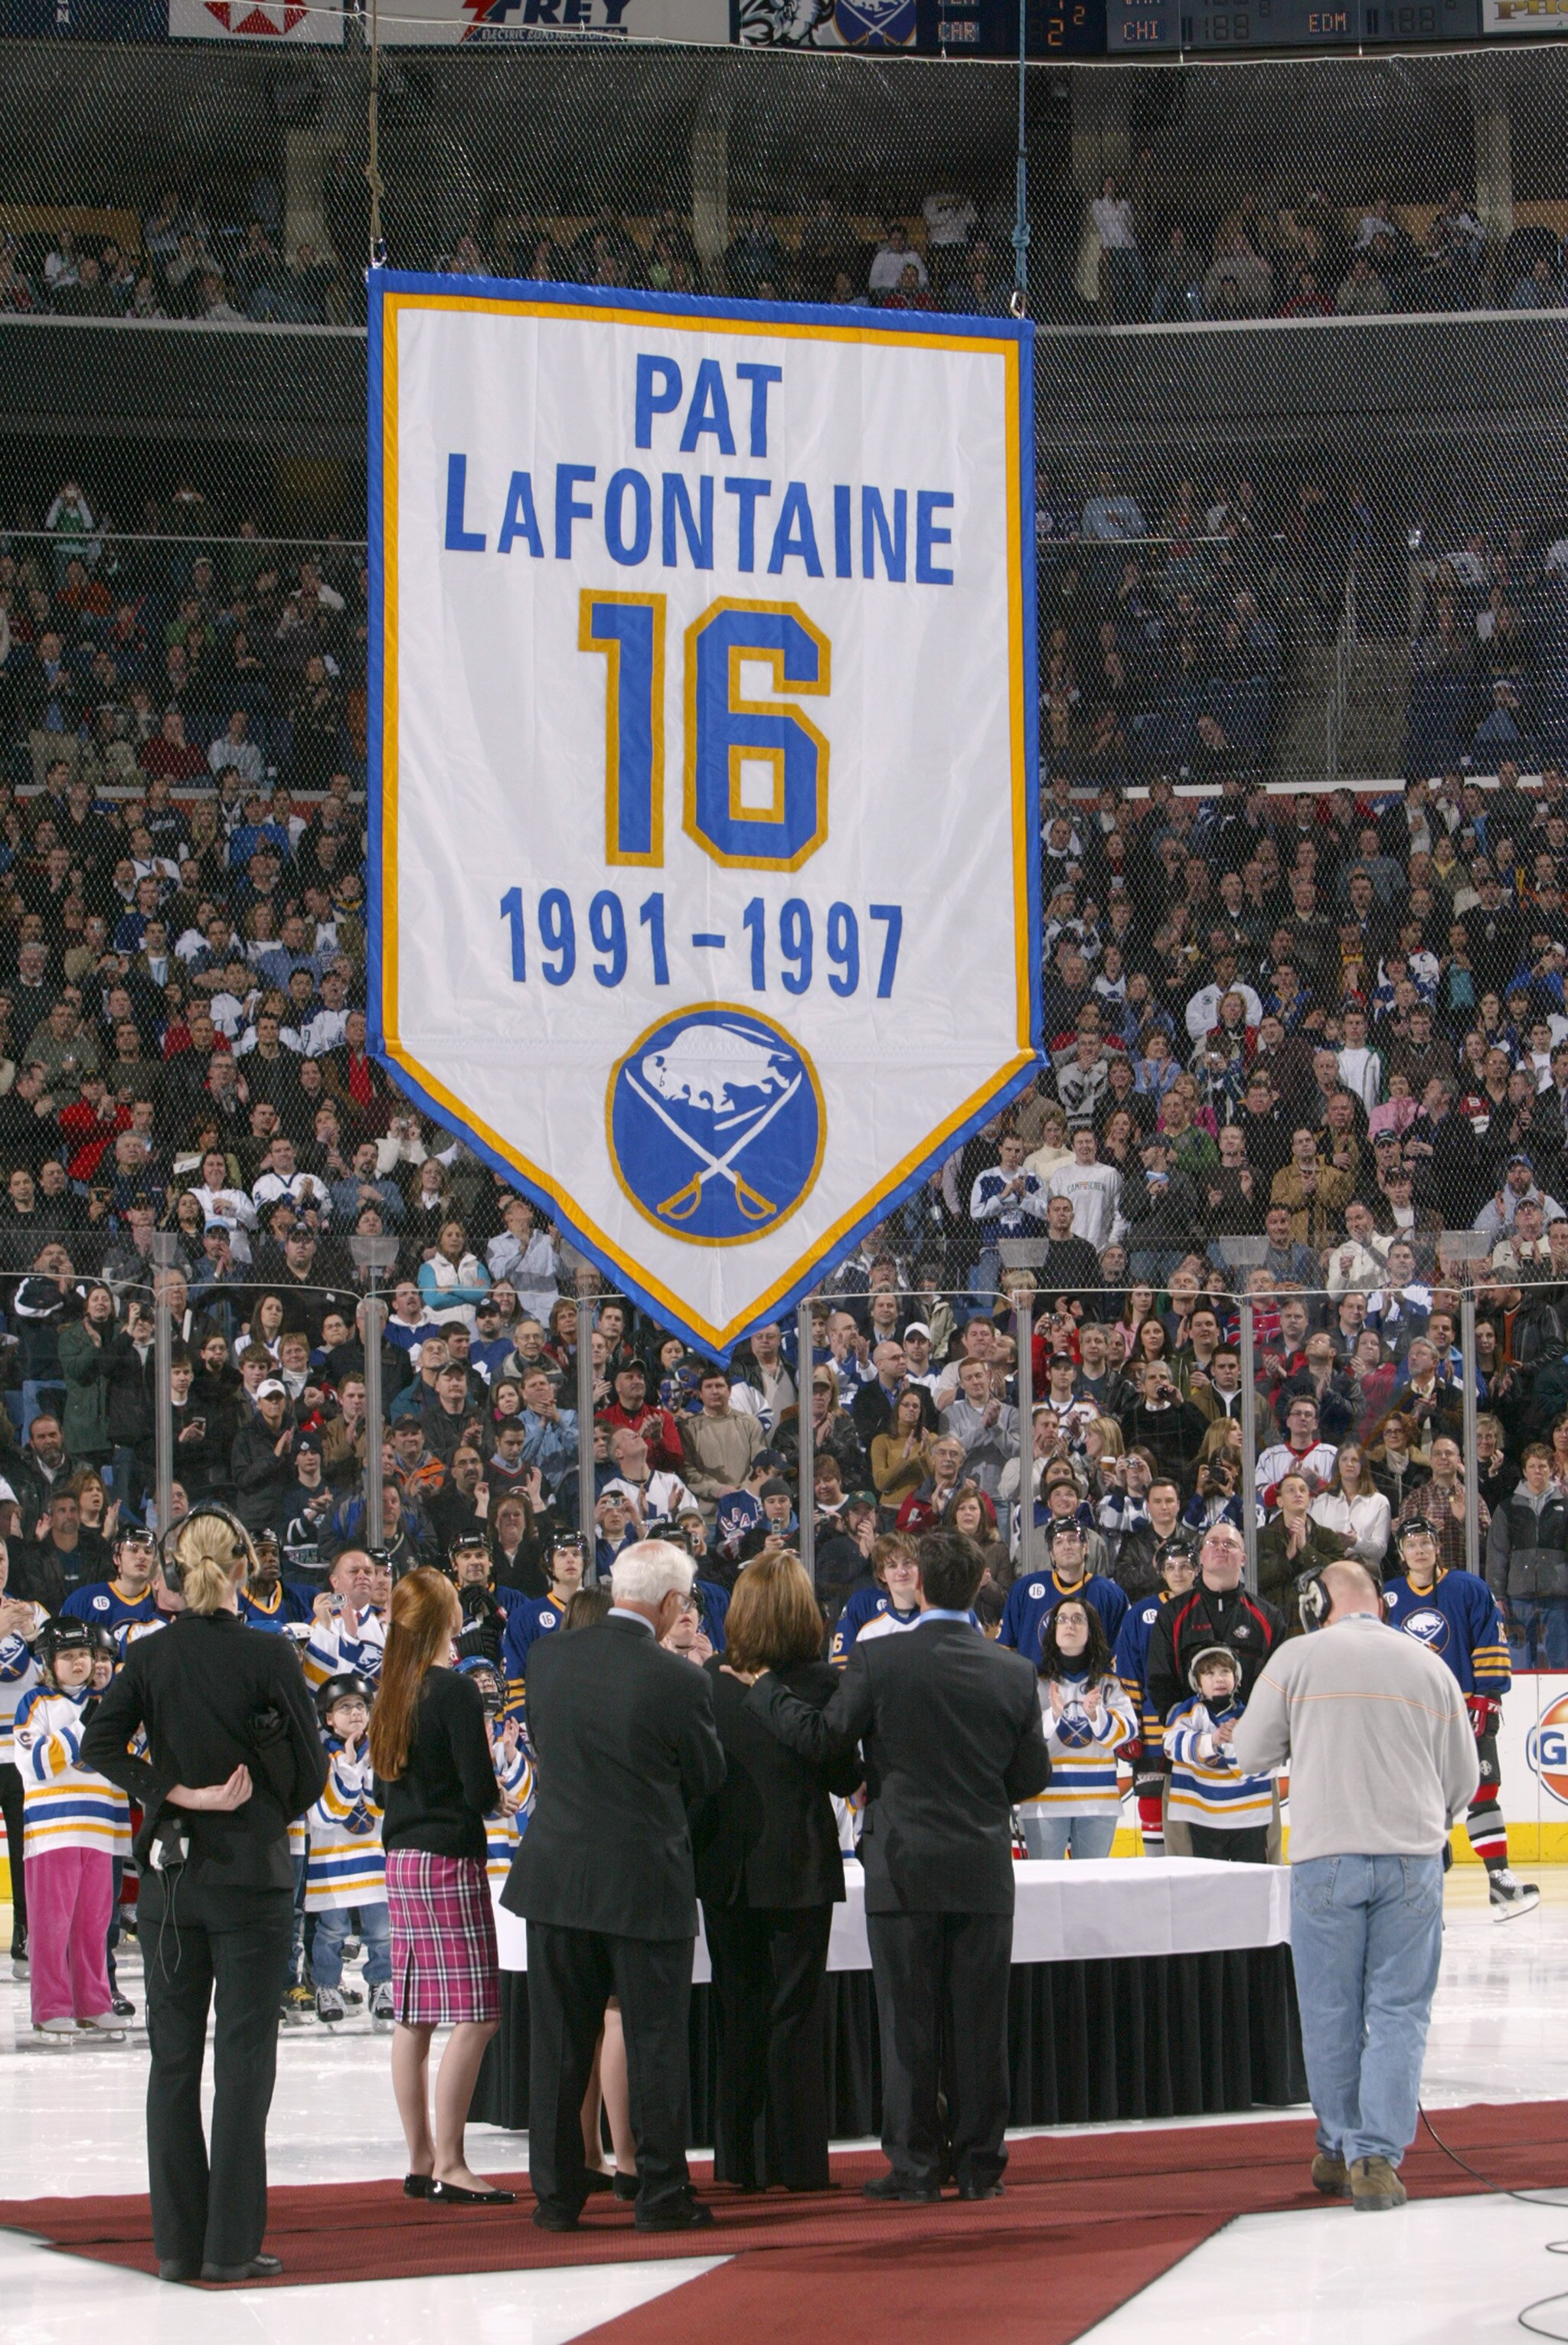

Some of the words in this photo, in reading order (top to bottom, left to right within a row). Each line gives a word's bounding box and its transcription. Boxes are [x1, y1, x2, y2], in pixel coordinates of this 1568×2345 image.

[1123, 20, 1158, 40] CHI
[1309, 12, 1346, 32] EDM
[635, 353, 782, 458] PAT
[577, 589, 831, 874] 16
